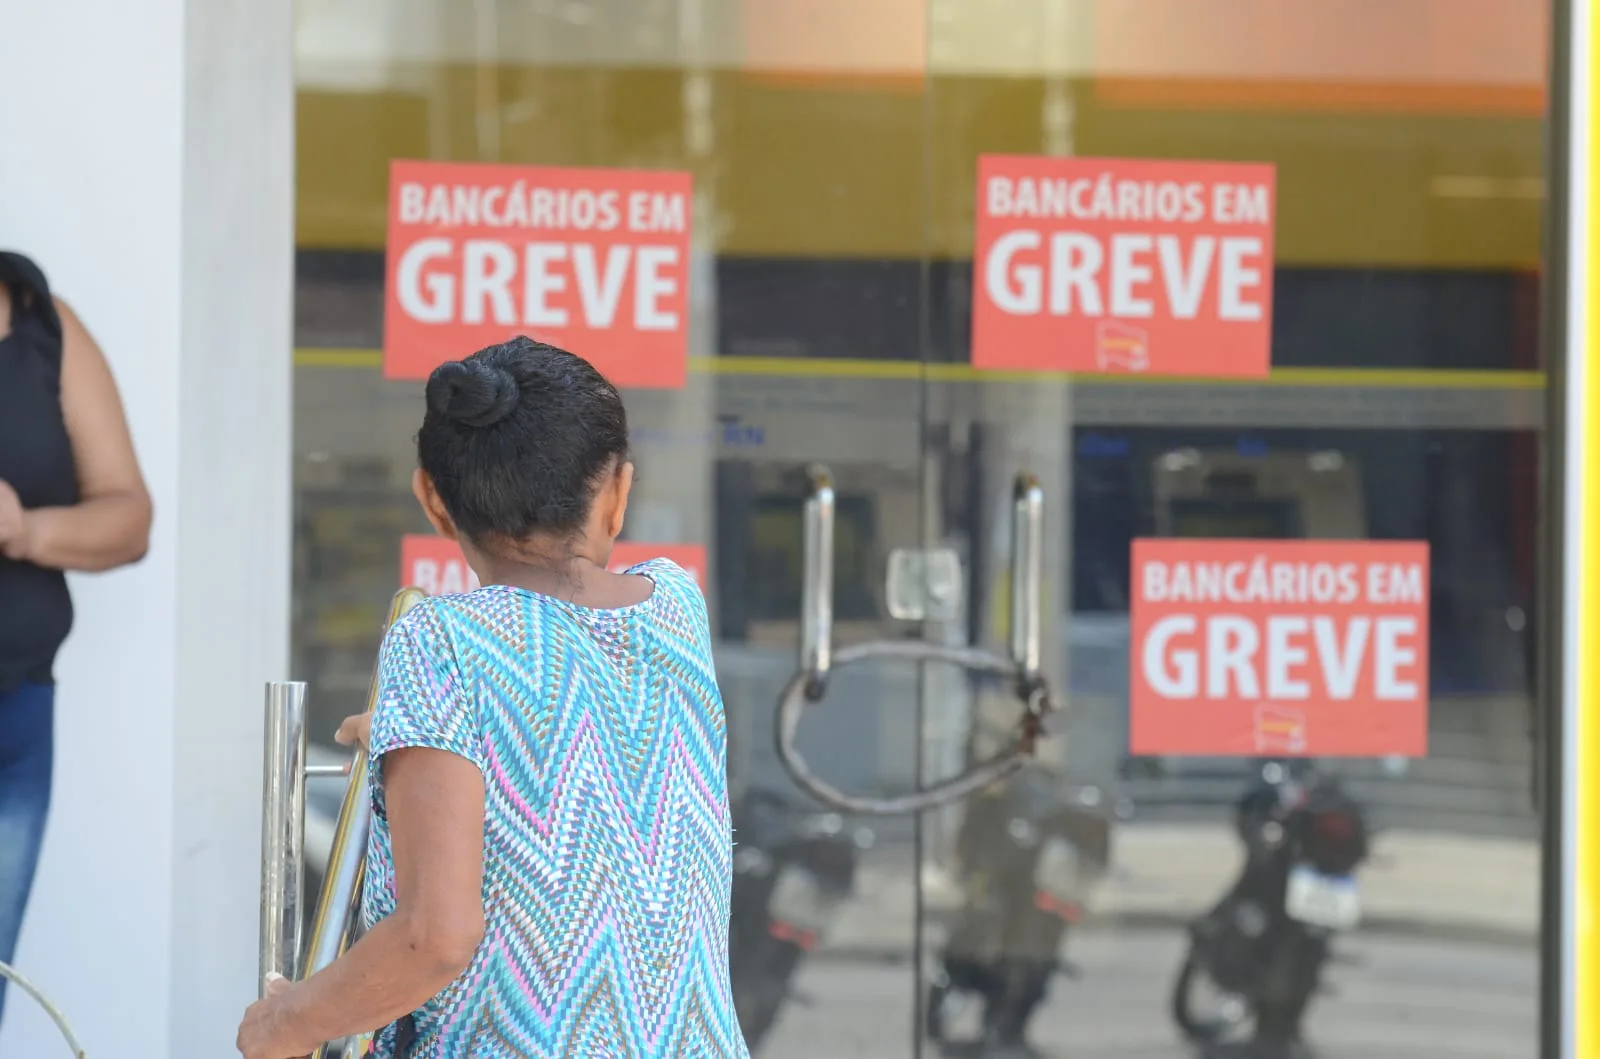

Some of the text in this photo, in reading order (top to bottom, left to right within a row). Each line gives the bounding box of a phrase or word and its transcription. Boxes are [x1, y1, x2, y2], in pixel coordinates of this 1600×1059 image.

[400, 181, 685, 232] BANCÁRIOS EM
[988, 174, 1268, 223] BANCÁRIOS EM
[397, 238, 679, 330] GREVE
[985, 230, 1262, 321] GREVE
[1143, 557, 1422, 603] BANCÁRIOS EM
[1142, 614, 1418, 700] GREVE
